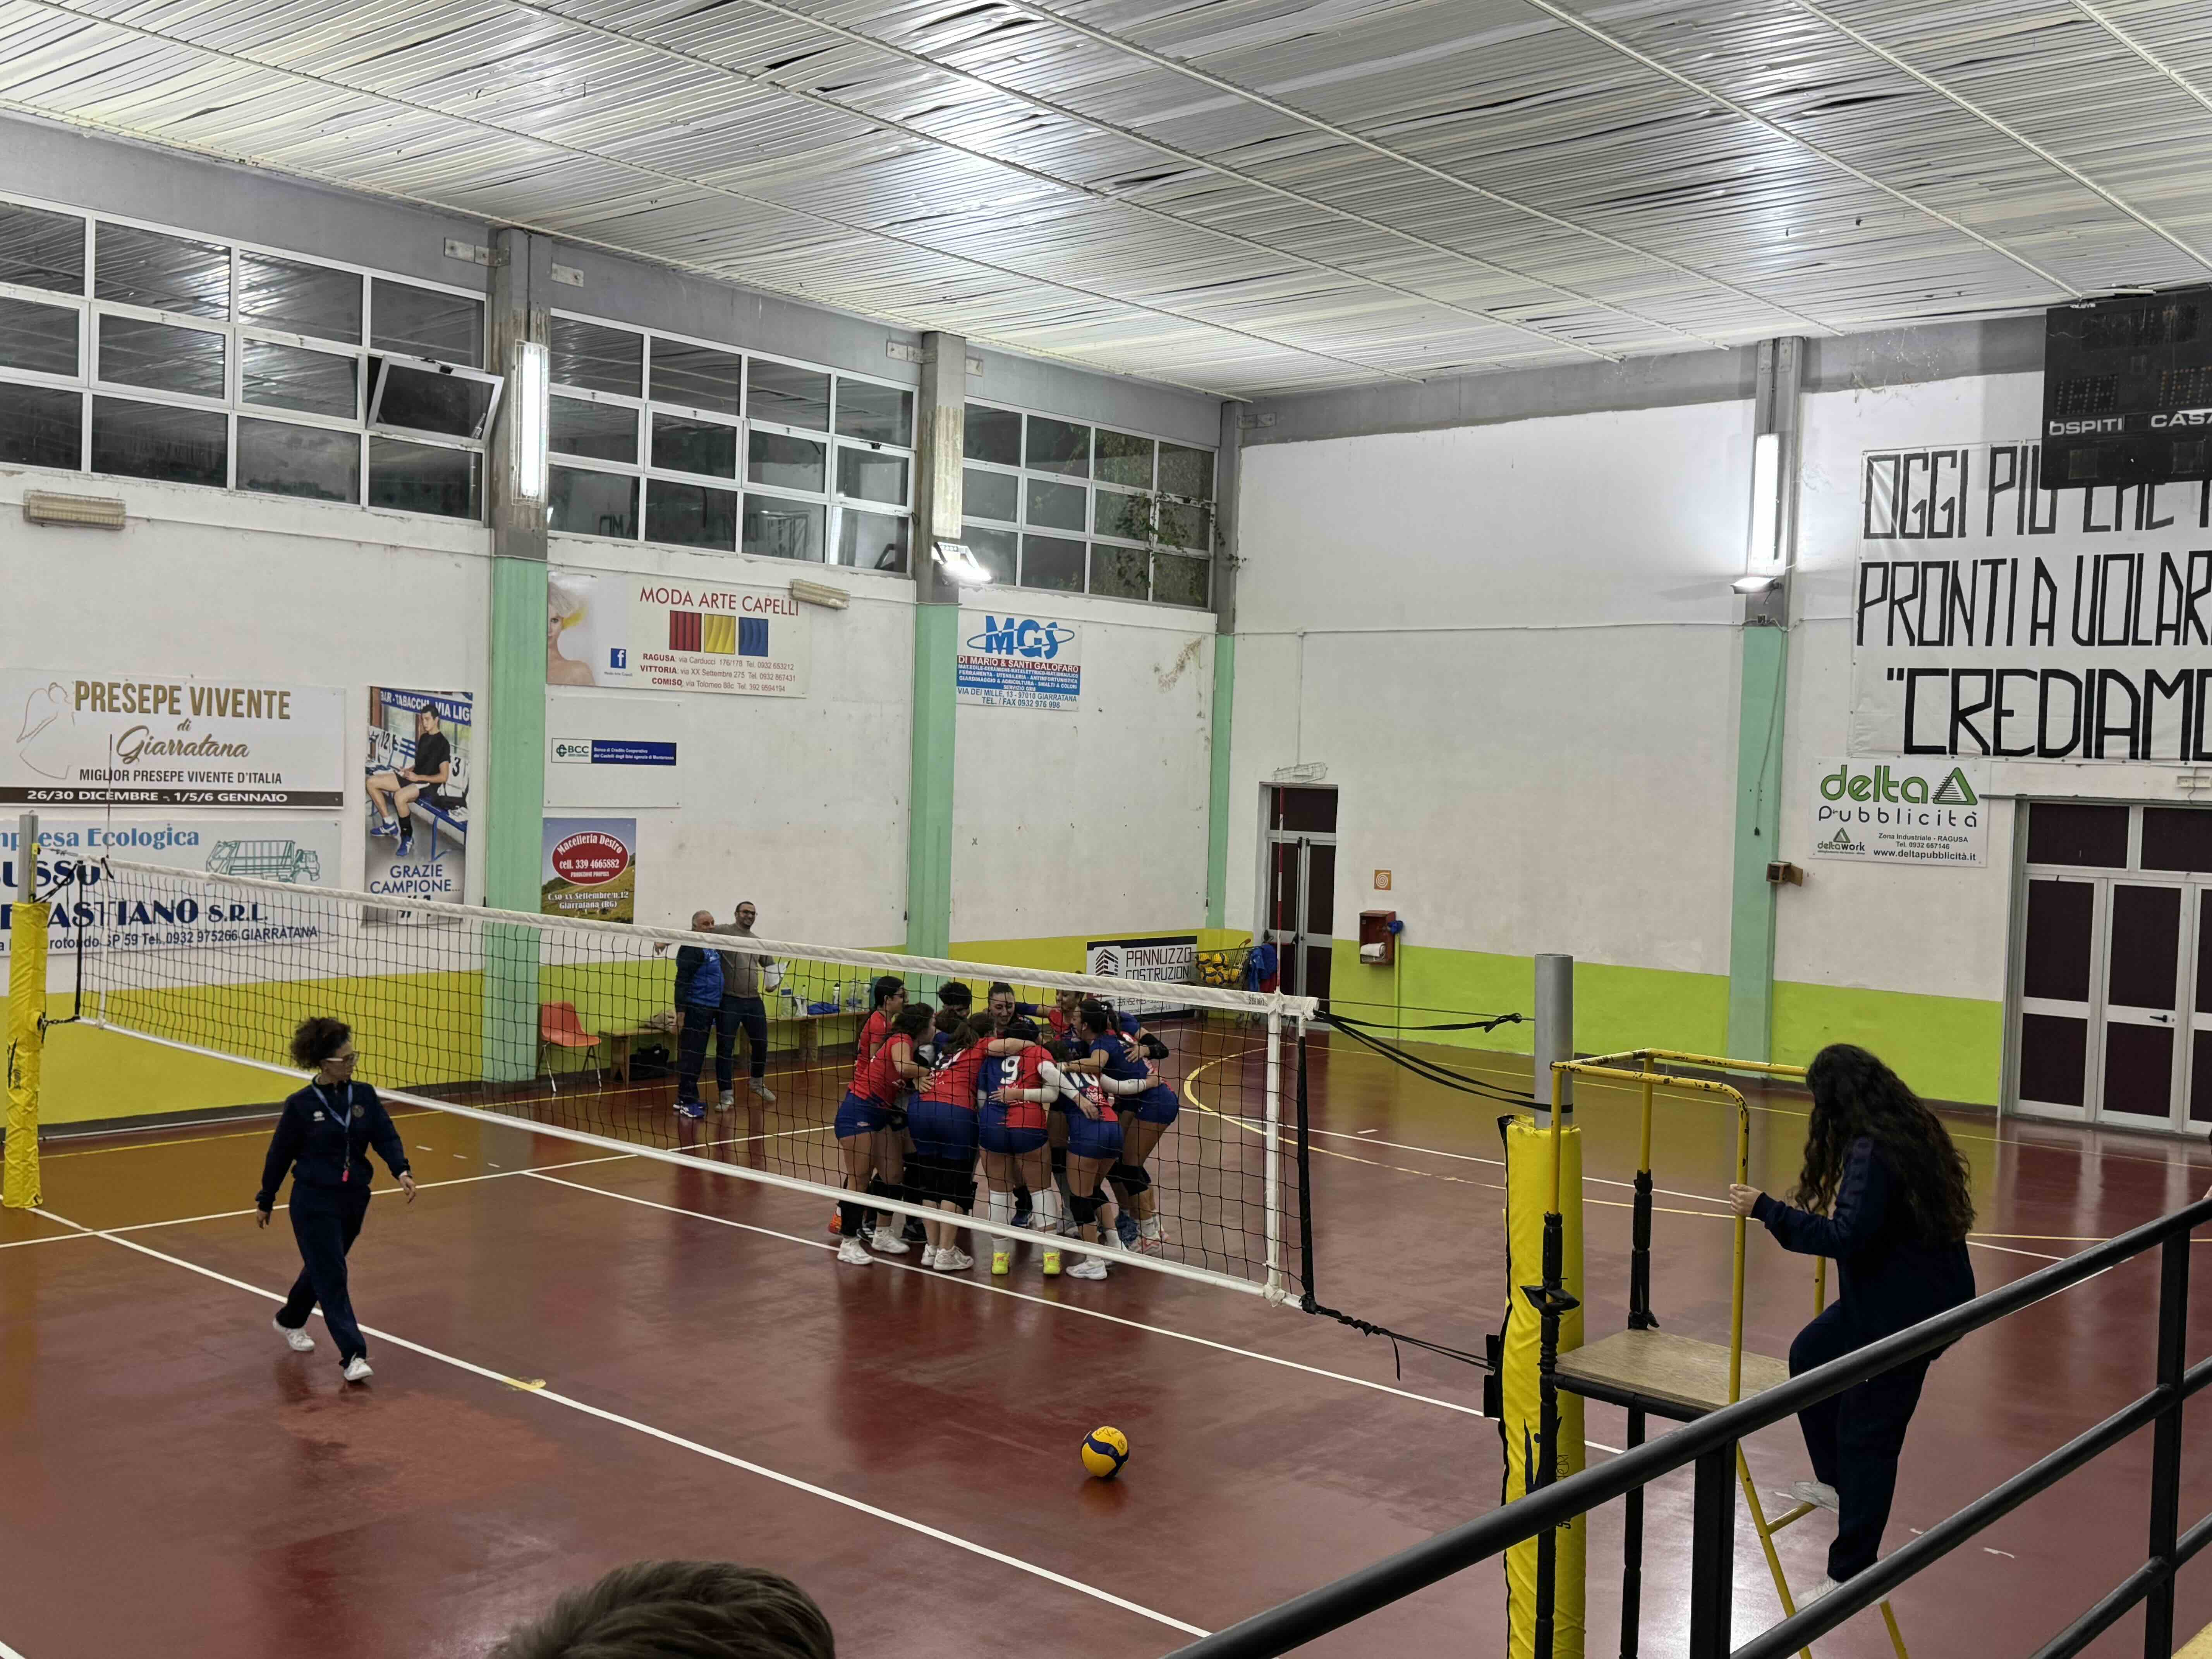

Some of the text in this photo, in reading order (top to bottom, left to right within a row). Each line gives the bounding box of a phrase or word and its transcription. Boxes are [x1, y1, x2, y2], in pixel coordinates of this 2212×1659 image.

[2049, 417, 2123, 436] OSPITI
[1863, 449, 1969, 539] OGGI
[640, 586, 799, 617] MODA ARTE CAPELLI
[1856, 558, 2018, 646] PRONTI
[2029, 556, 2057, 646] A
[985, 616, 1058, 659] MGS
[689, 657, 716, 665] Carducci
[970, 657, 998, 666] MARIO
[1008, 660, 1032, 668] SANTI
[1034, 663, 1078, 673] GALOFARO
[702, 669, 732, 678] Settembre
[75, 680, 291, 719] PRESEPE VIVENTE
[1037, 694, 1077, 702] GIARRATANA
[435, 701, 451, 717] VIA
[177, 719, 191, 732] di
[116, 725, 249, 764] Giarratana
[568, 745, 589, 753] BCC
[79, 769, 282, 784] MIGLIOR PRESEPE VIVENTE D'ITALIA
[1820, 764, 1928, 804] delta
[27, 790, 74, 801] 26/30
[79, 791, 158, 801] DICEMBRE
[174, 792, 214, 802] 1/5/6
[217, 793, 288, 802] GENNAIO
[88, 827, 200, 850] Ecologica
[556, 834, 623, 855] Macelleria Destro
[1817, 841, 1865, 851] deltawork
[390, 864, 443, 878] GRAZIE
[575, 859, 588, 869] 339
[208, 904, 268, 923] S.R.L.
[125, 934, 138, 946] 59
[167, 931, 193, 944] 0932
[198, 930, 237, 942] 975266
[242, 926, 318, 940] GIARRATANA
[1126, 947, 1192, 967] PANNUZZO
[1001, 1056, 1020, 1085] 9
